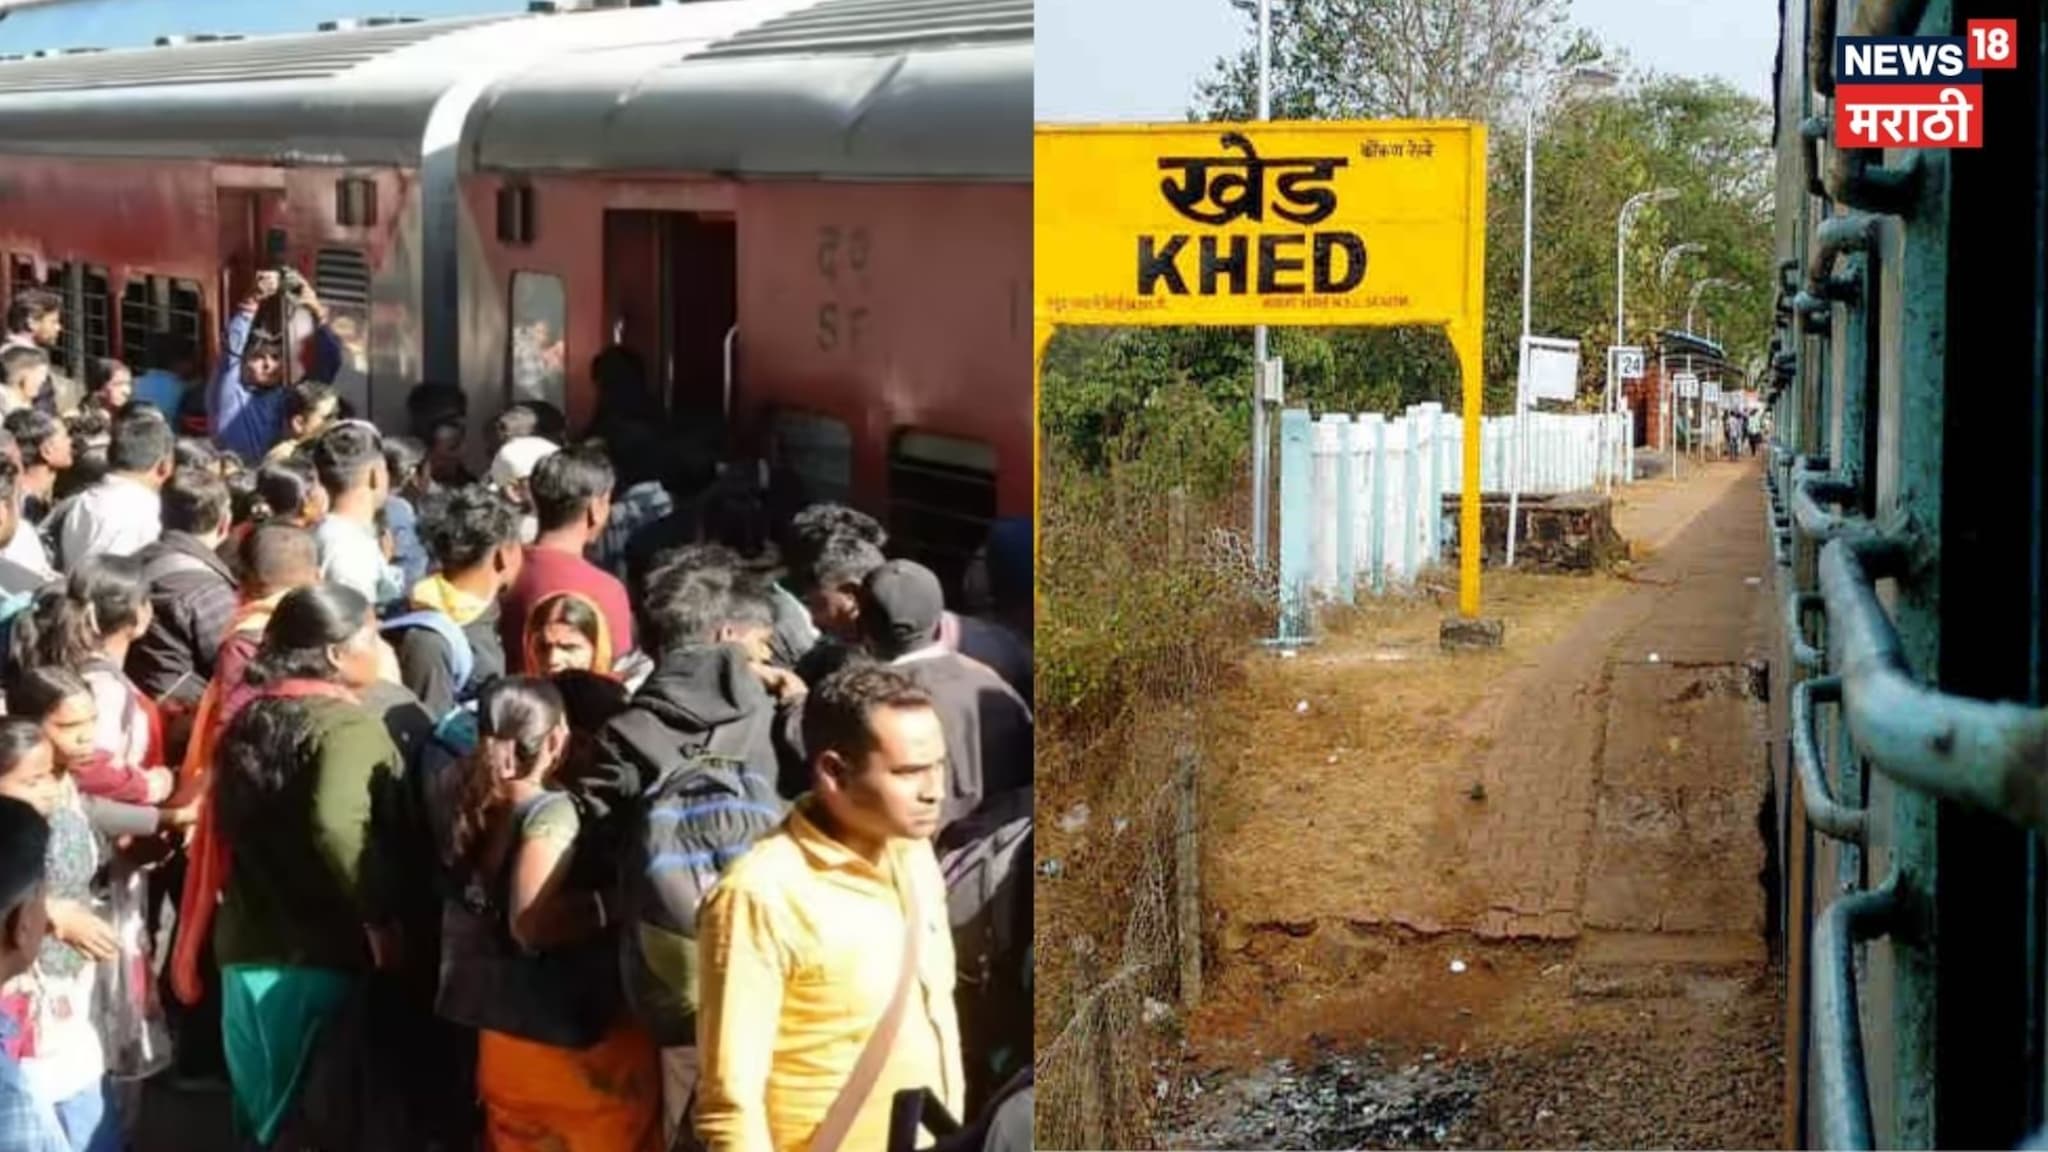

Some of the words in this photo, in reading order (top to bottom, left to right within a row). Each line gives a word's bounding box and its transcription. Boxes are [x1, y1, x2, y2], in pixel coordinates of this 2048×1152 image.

[1158, 132, 1348, 226] खेड
[1137, 231, 1368, 296] KHED
[1622, 356, 1641, 375] 24
